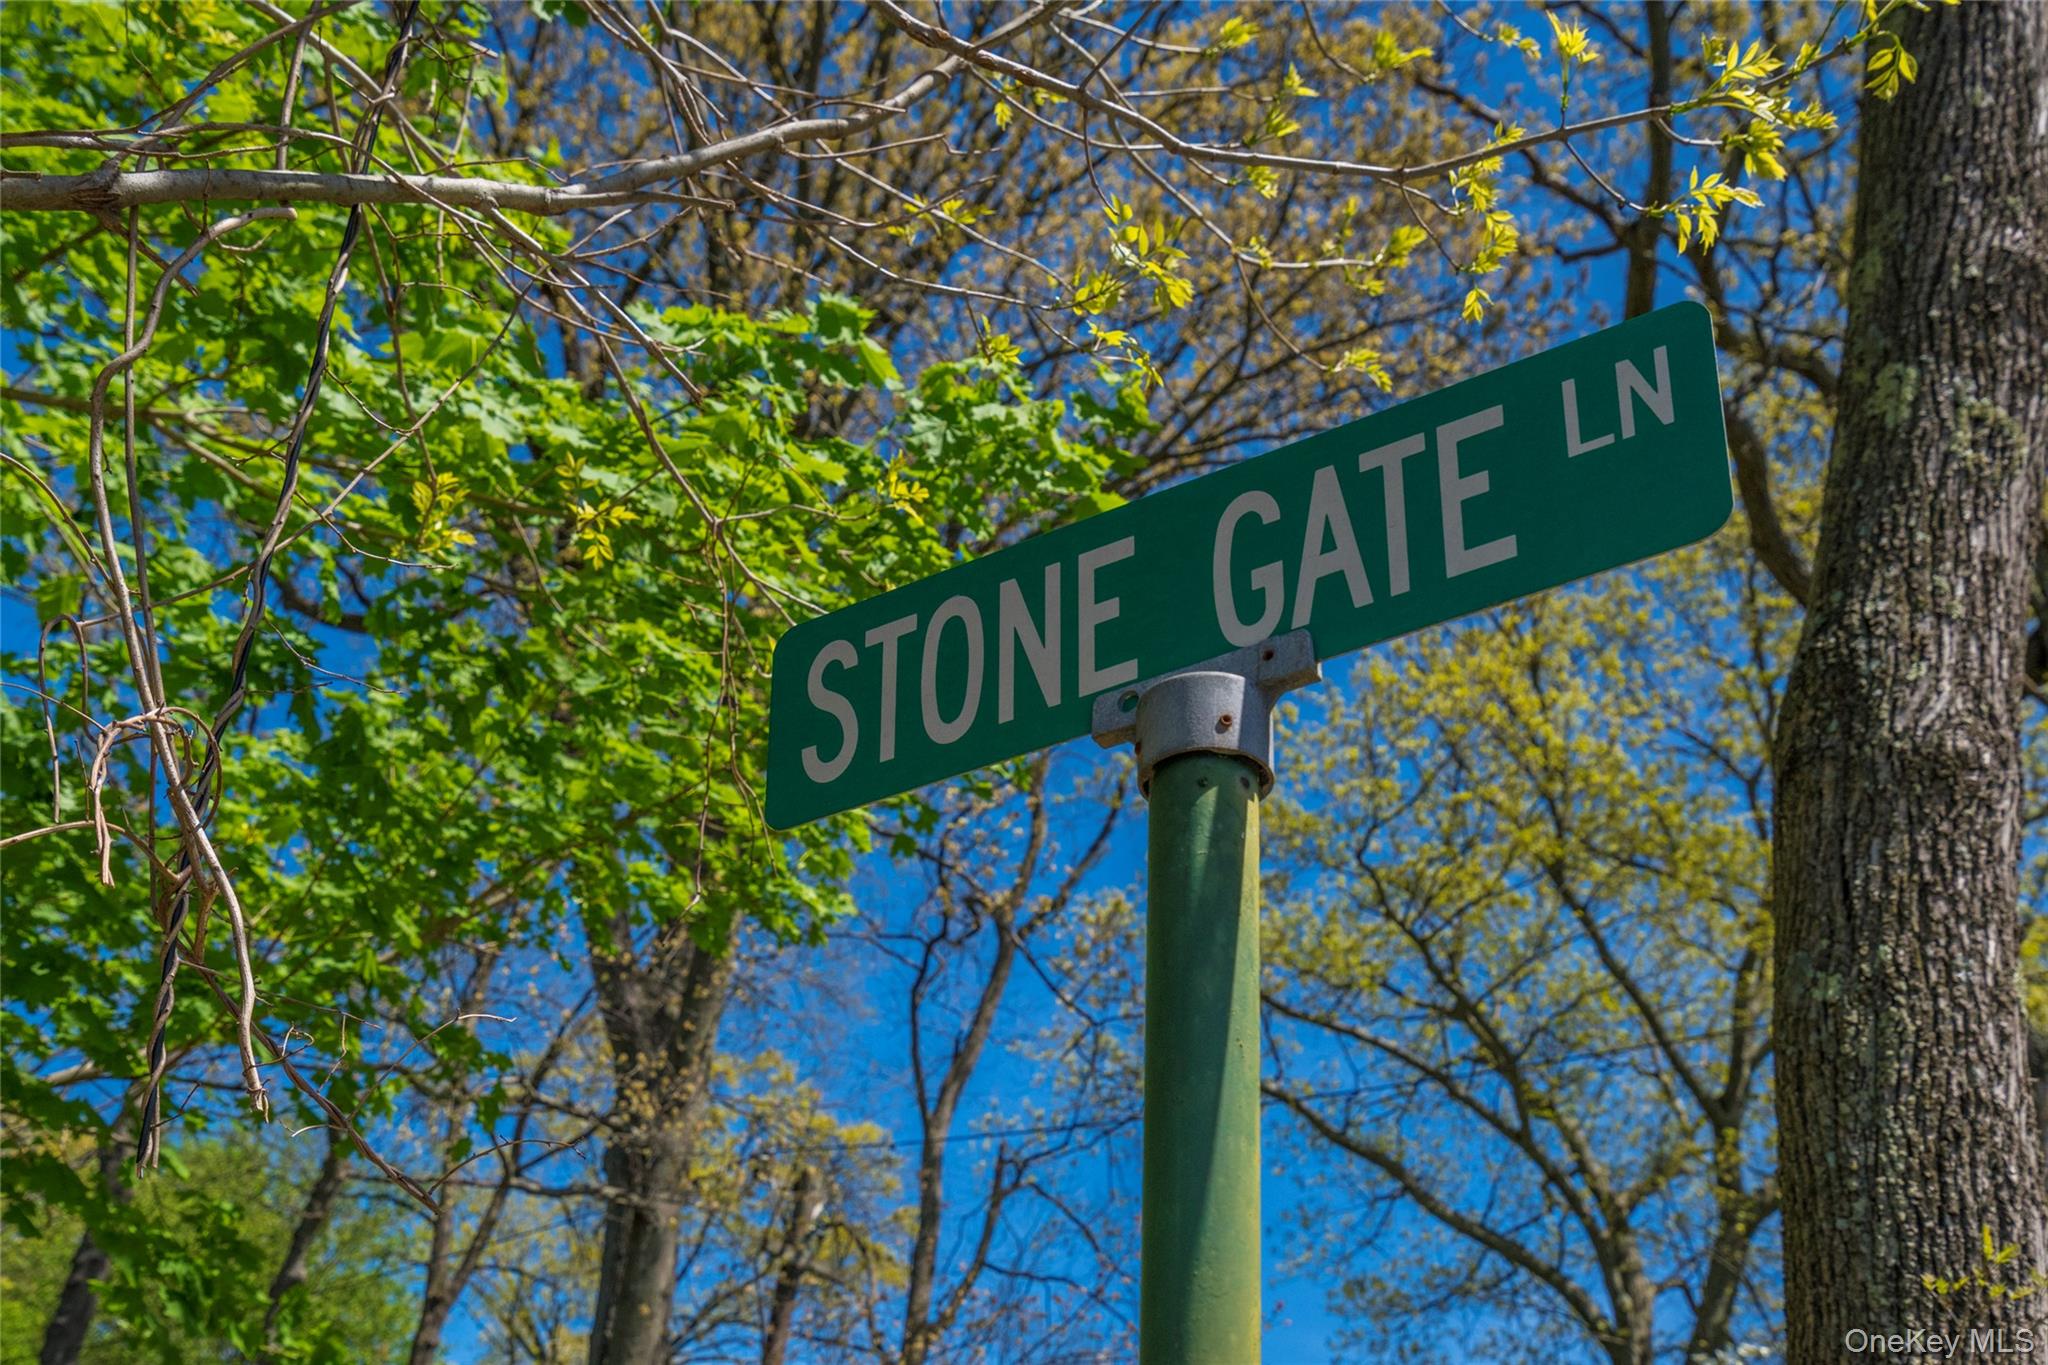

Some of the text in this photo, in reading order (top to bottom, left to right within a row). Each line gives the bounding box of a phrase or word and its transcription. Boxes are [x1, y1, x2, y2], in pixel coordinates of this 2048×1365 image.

[801, 345, 1675, 784] STONE GATE LN
